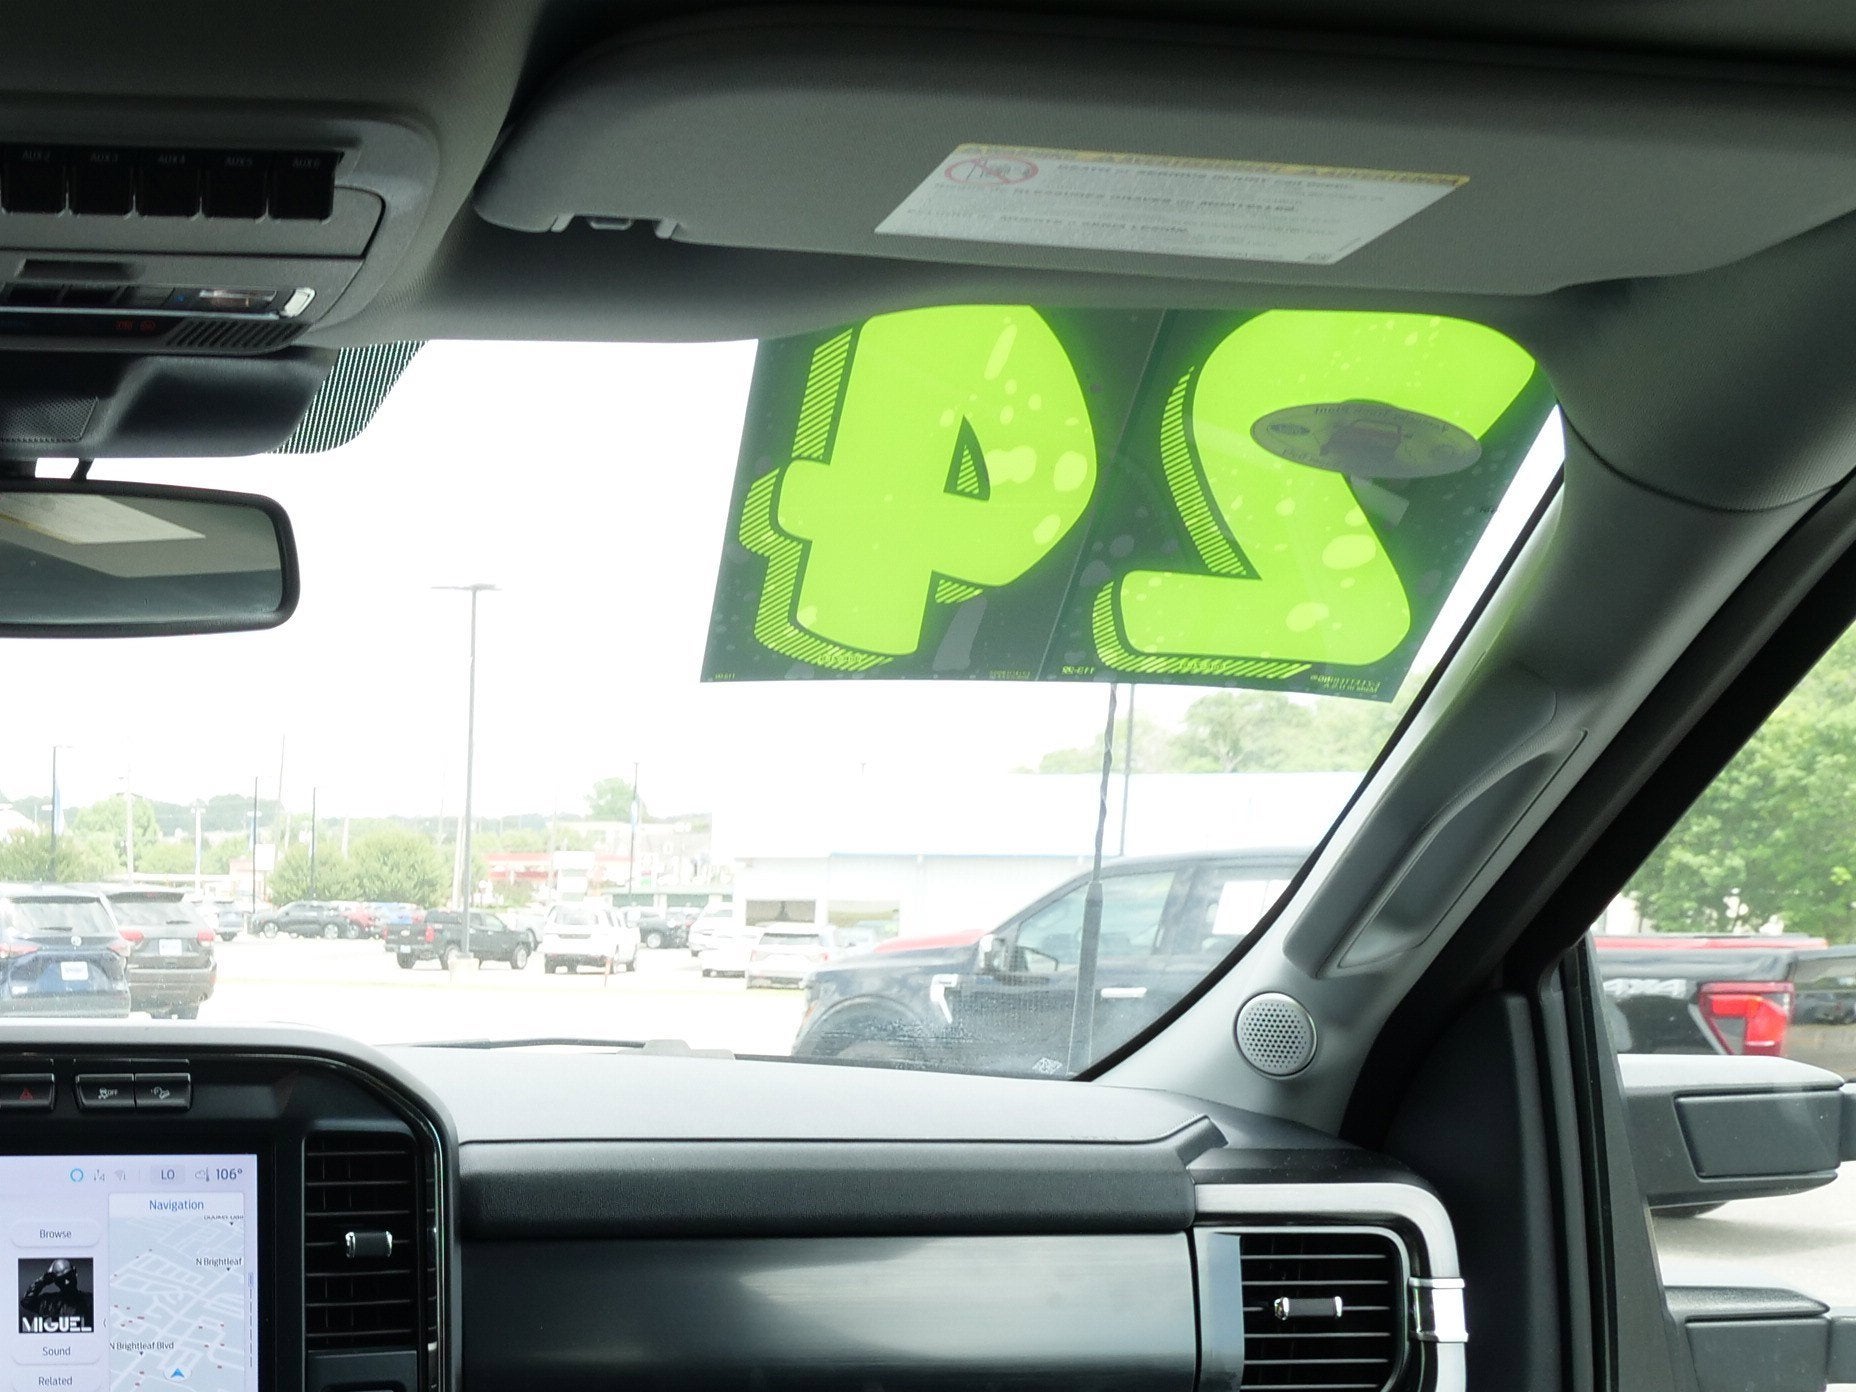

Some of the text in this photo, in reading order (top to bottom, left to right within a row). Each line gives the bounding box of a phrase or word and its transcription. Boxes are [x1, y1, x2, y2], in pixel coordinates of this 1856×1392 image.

[161, 1169, 175, 1180] LO
[149, 1199, 205, 1212] Navigation
[39, 1229, 72, 1240] Browse
[203, 1257, 243, 1269] Brightleaf
[21, 1316, 93, 1333] MIGUEL
[42, 1346, 71, 1356] Sound
[116, 1341, 156, 1351] Brightleaf
[157, 1341, 175, 1350] Blvd
[38, 1376, 73, 1386] Related
